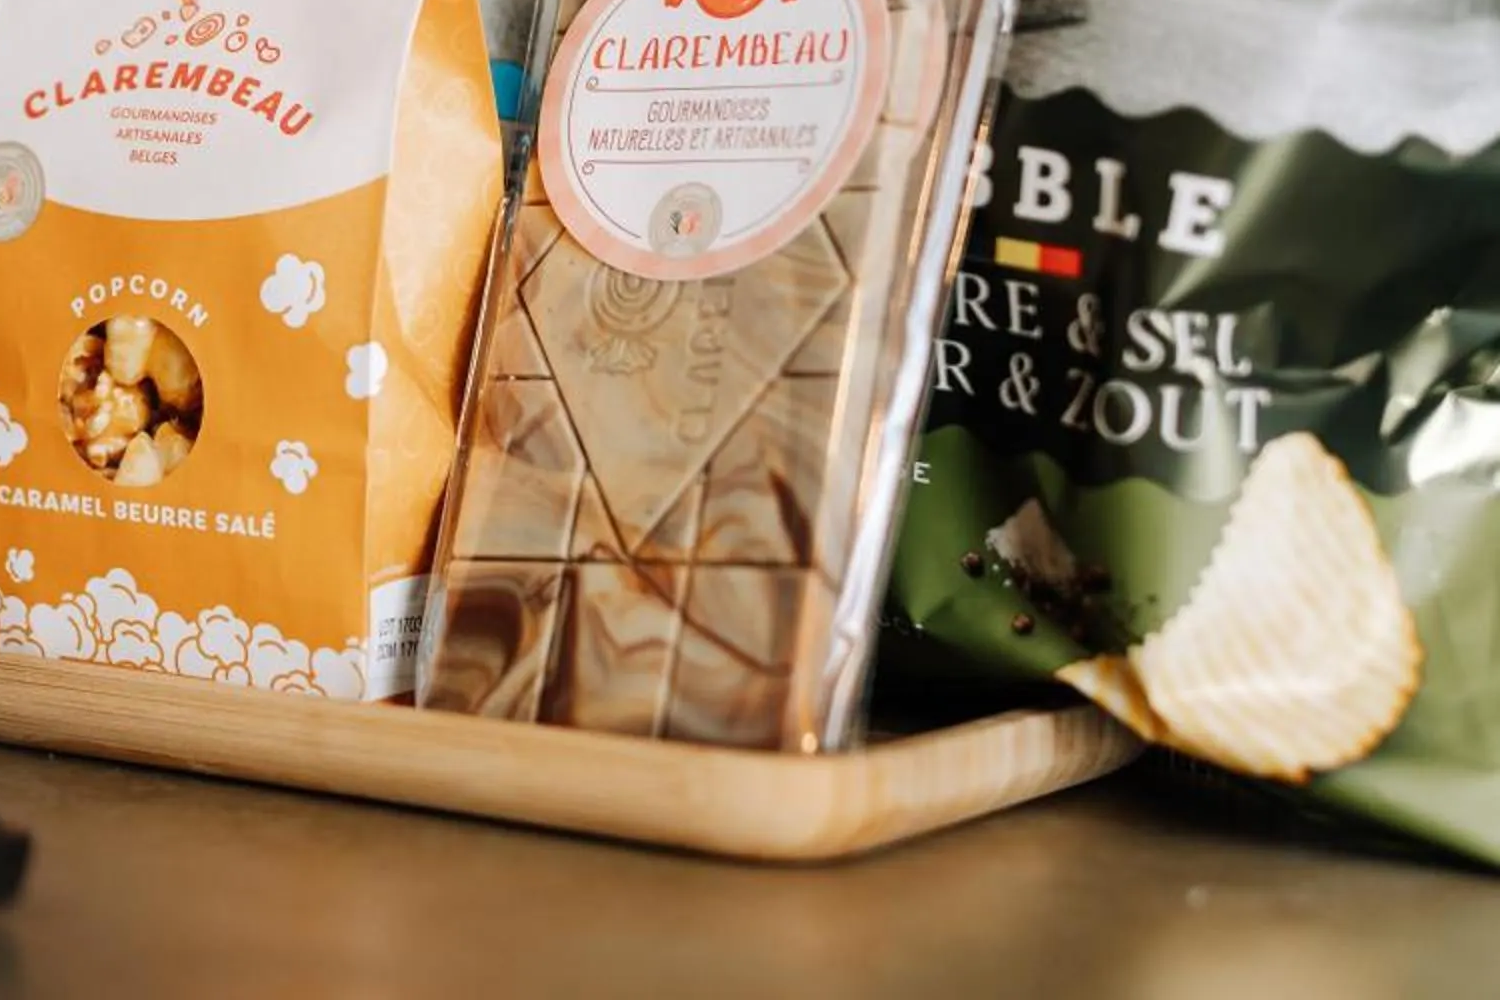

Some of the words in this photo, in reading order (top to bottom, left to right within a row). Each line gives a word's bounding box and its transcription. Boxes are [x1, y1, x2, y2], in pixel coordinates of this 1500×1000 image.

[592, 28, 848, 71] CLAREMBEAU
[22, 61, 314, 137] CLAREMBEAU
[109, 106, 220, 127] GOURMANDISES
[646, 98, 771, 124] GOURMANDISES
[115, 127, 205, 146] ARTISANALES
[588, 127, 687, 151] NATURELLES
[689, 127, 711, 150] ET
[714, 124, 819, 150] ARTISANALES
[128, 149, 179, 166] BELGES
[70, 273, 209, 329] POPCORN
[1065, 292, 1105, 356] &
[1121, 308, 1254, 379] SEL
[999, 352, 1042, 416] &
[1059, 366, 1274, 452] ZOUT
[113, 501, 208, 530] BEURRE
[214, 511, 276, 539] SALÉ
